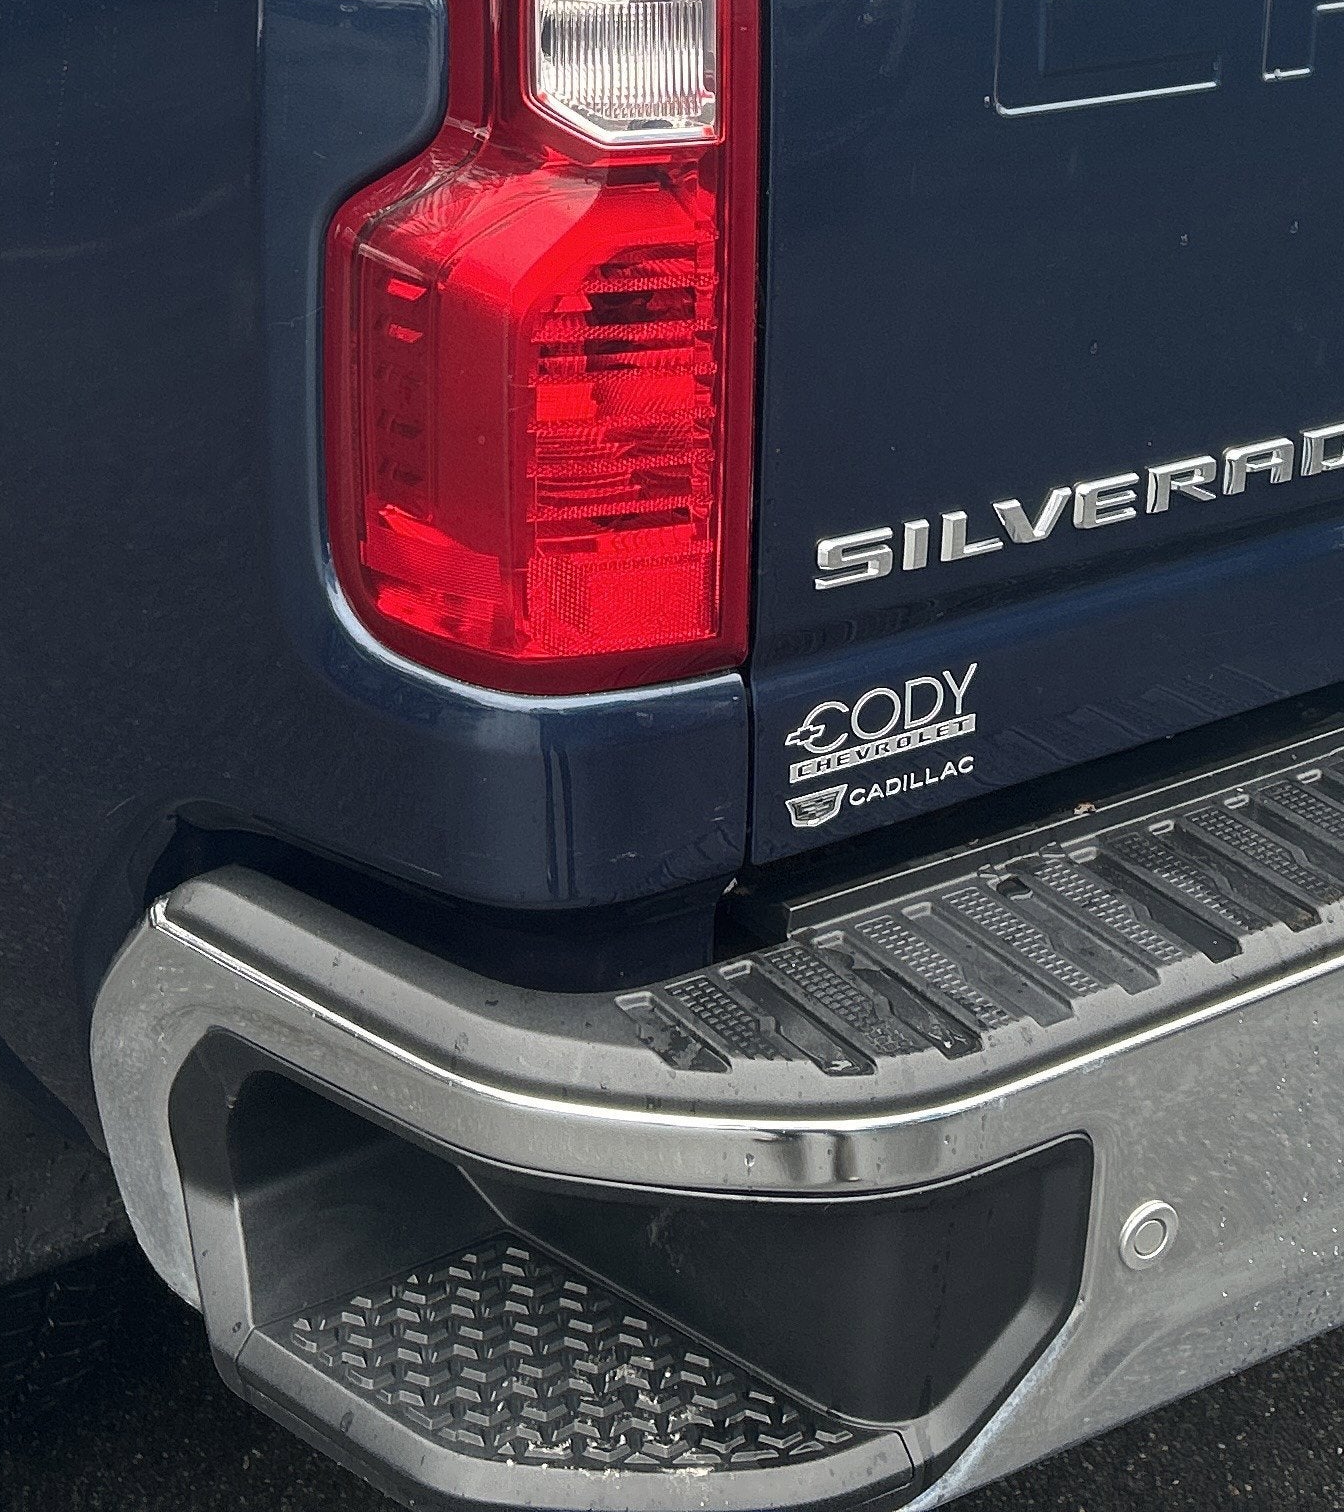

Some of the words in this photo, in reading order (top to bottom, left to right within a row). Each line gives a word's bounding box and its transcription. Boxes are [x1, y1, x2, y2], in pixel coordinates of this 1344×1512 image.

[803, 662, 978, 754] CODY
[797, 718, 971, 778] CHEVROLET
[849, 756, 975, 806] CADILLAC
